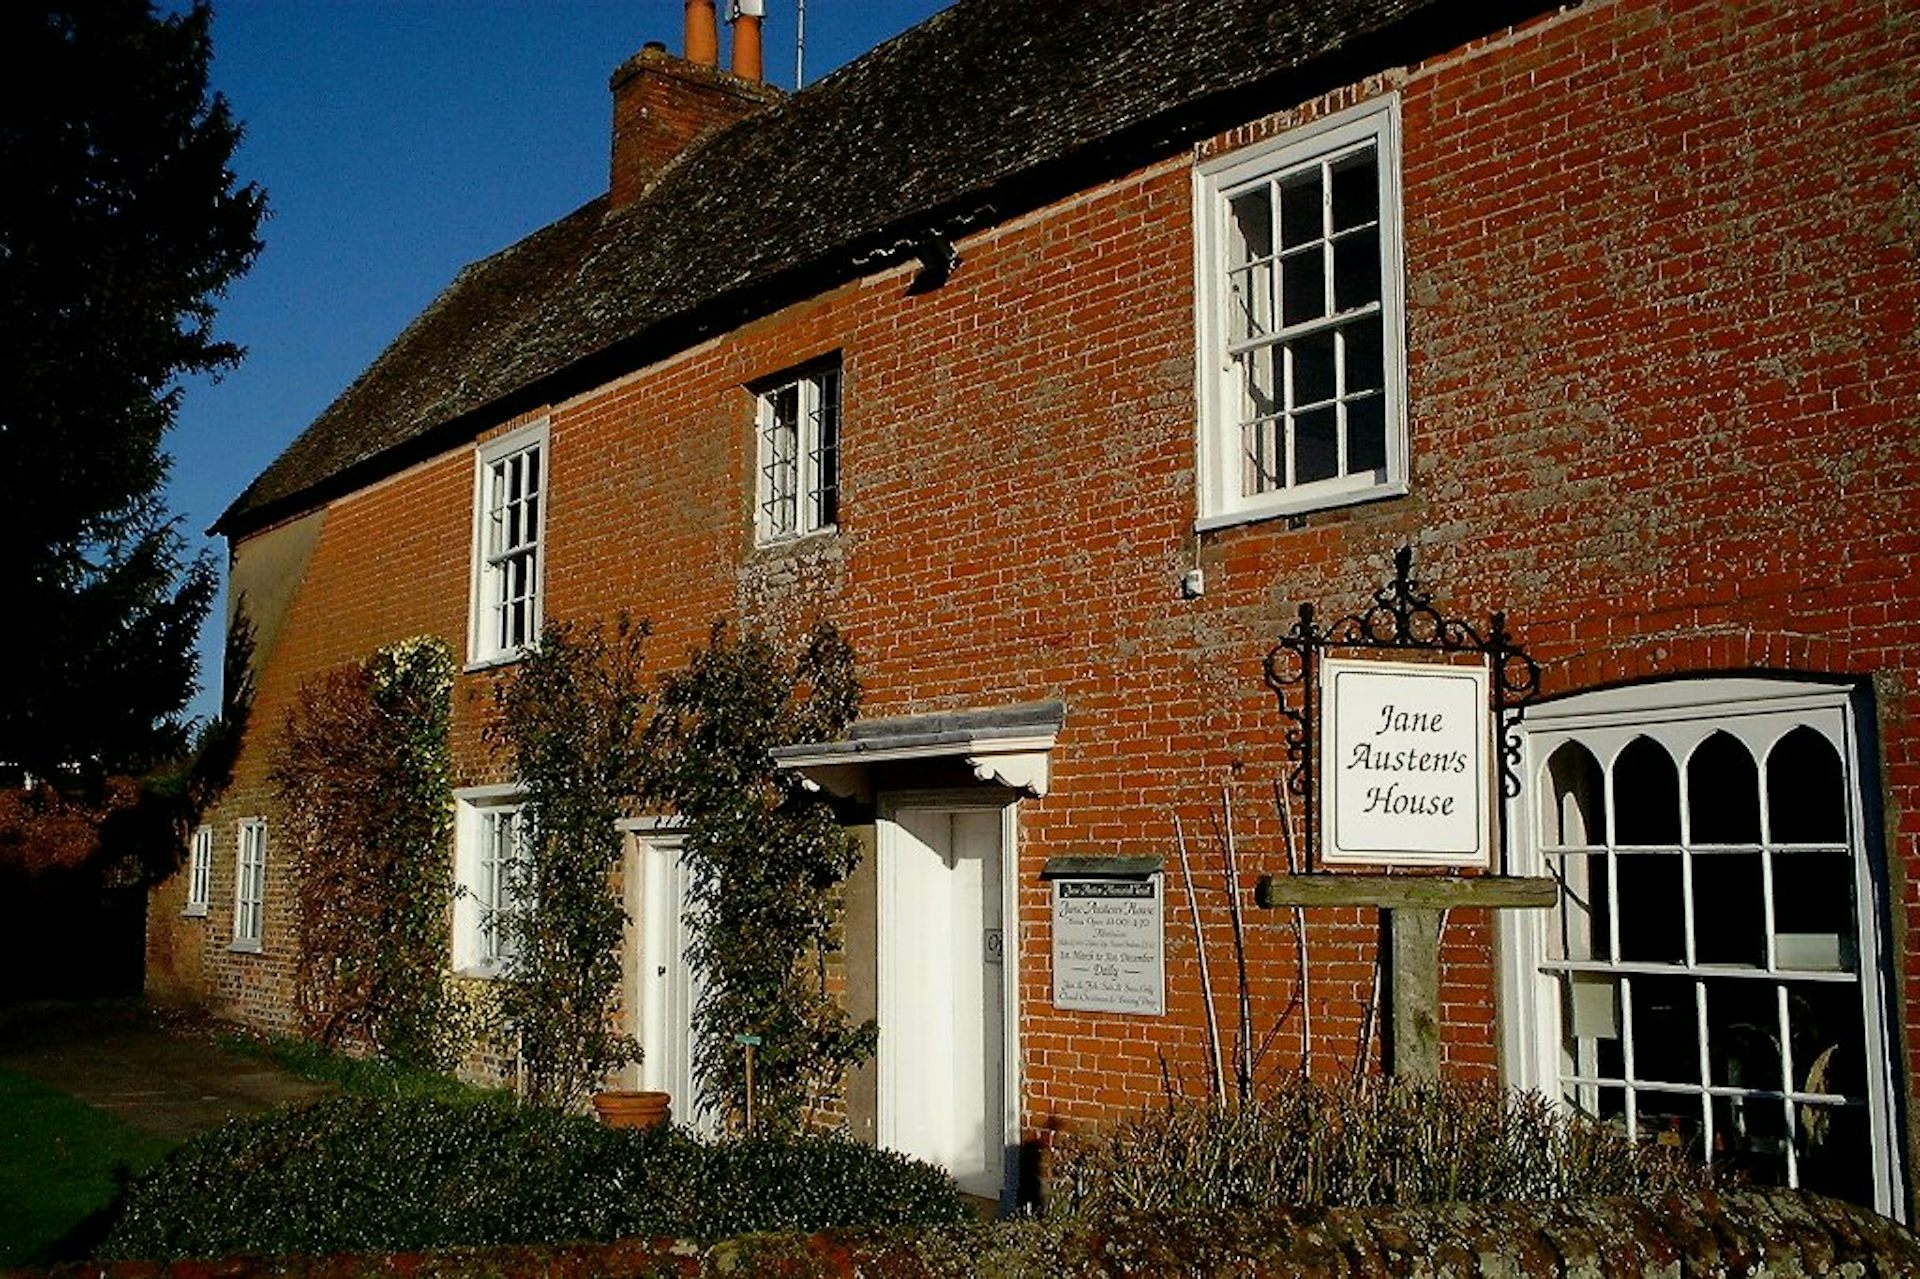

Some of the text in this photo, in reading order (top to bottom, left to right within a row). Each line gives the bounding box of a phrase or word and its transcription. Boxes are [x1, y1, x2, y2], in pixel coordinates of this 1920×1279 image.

[1375, 704, 1443, 736] Jane
[1346, 742, 1468, 774] Austen's
[1362, 782, 1455, 817] House
